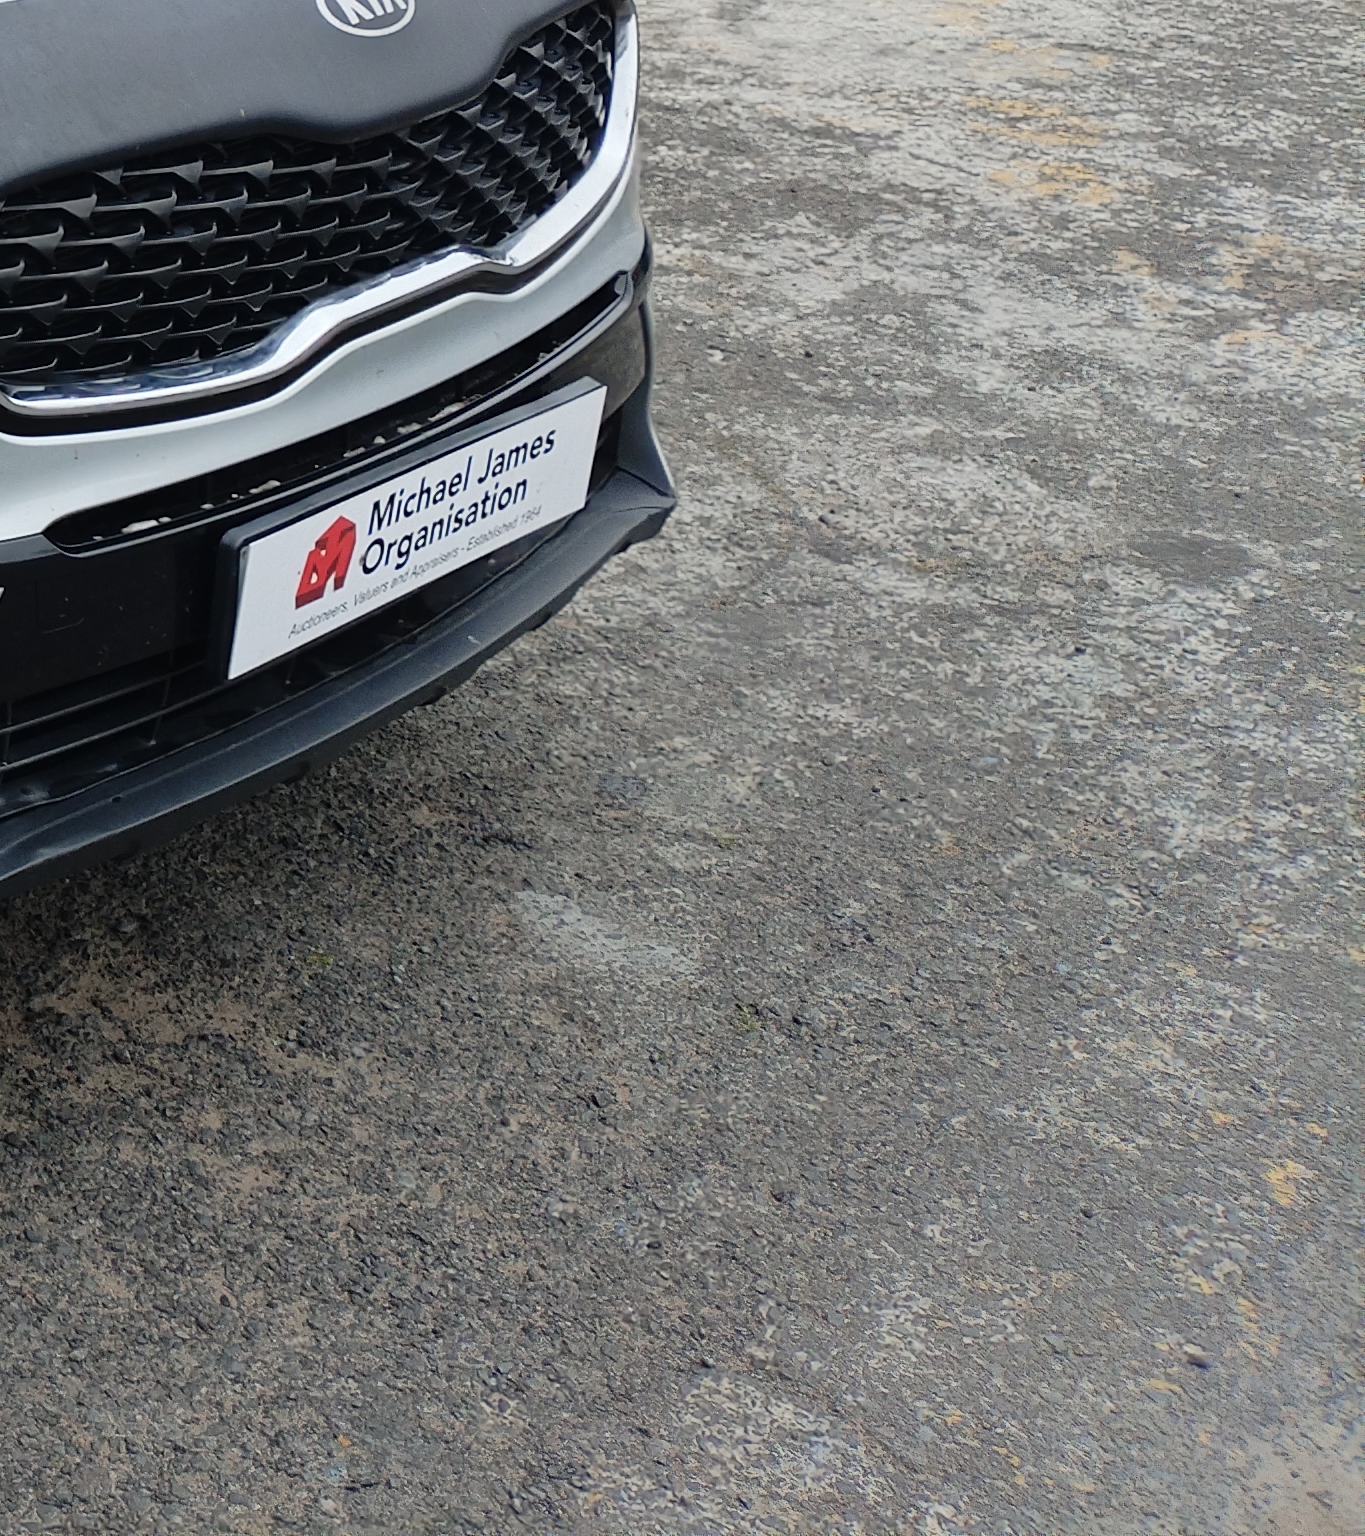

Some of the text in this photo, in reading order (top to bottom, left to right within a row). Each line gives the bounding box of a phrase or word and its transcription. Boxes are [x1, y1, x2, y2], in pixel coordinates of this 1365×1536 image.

[360, 478, 528, 576] Organisation
[367, 429, 557, 536] Michael James
[354, 580, 390, 607] Valuers
[390, 570, 411, 590] and
[410, 546, 459, 580] Appraisers
[466, 515, 519, 552] Established
[519, 505, 543, 524] 1964
